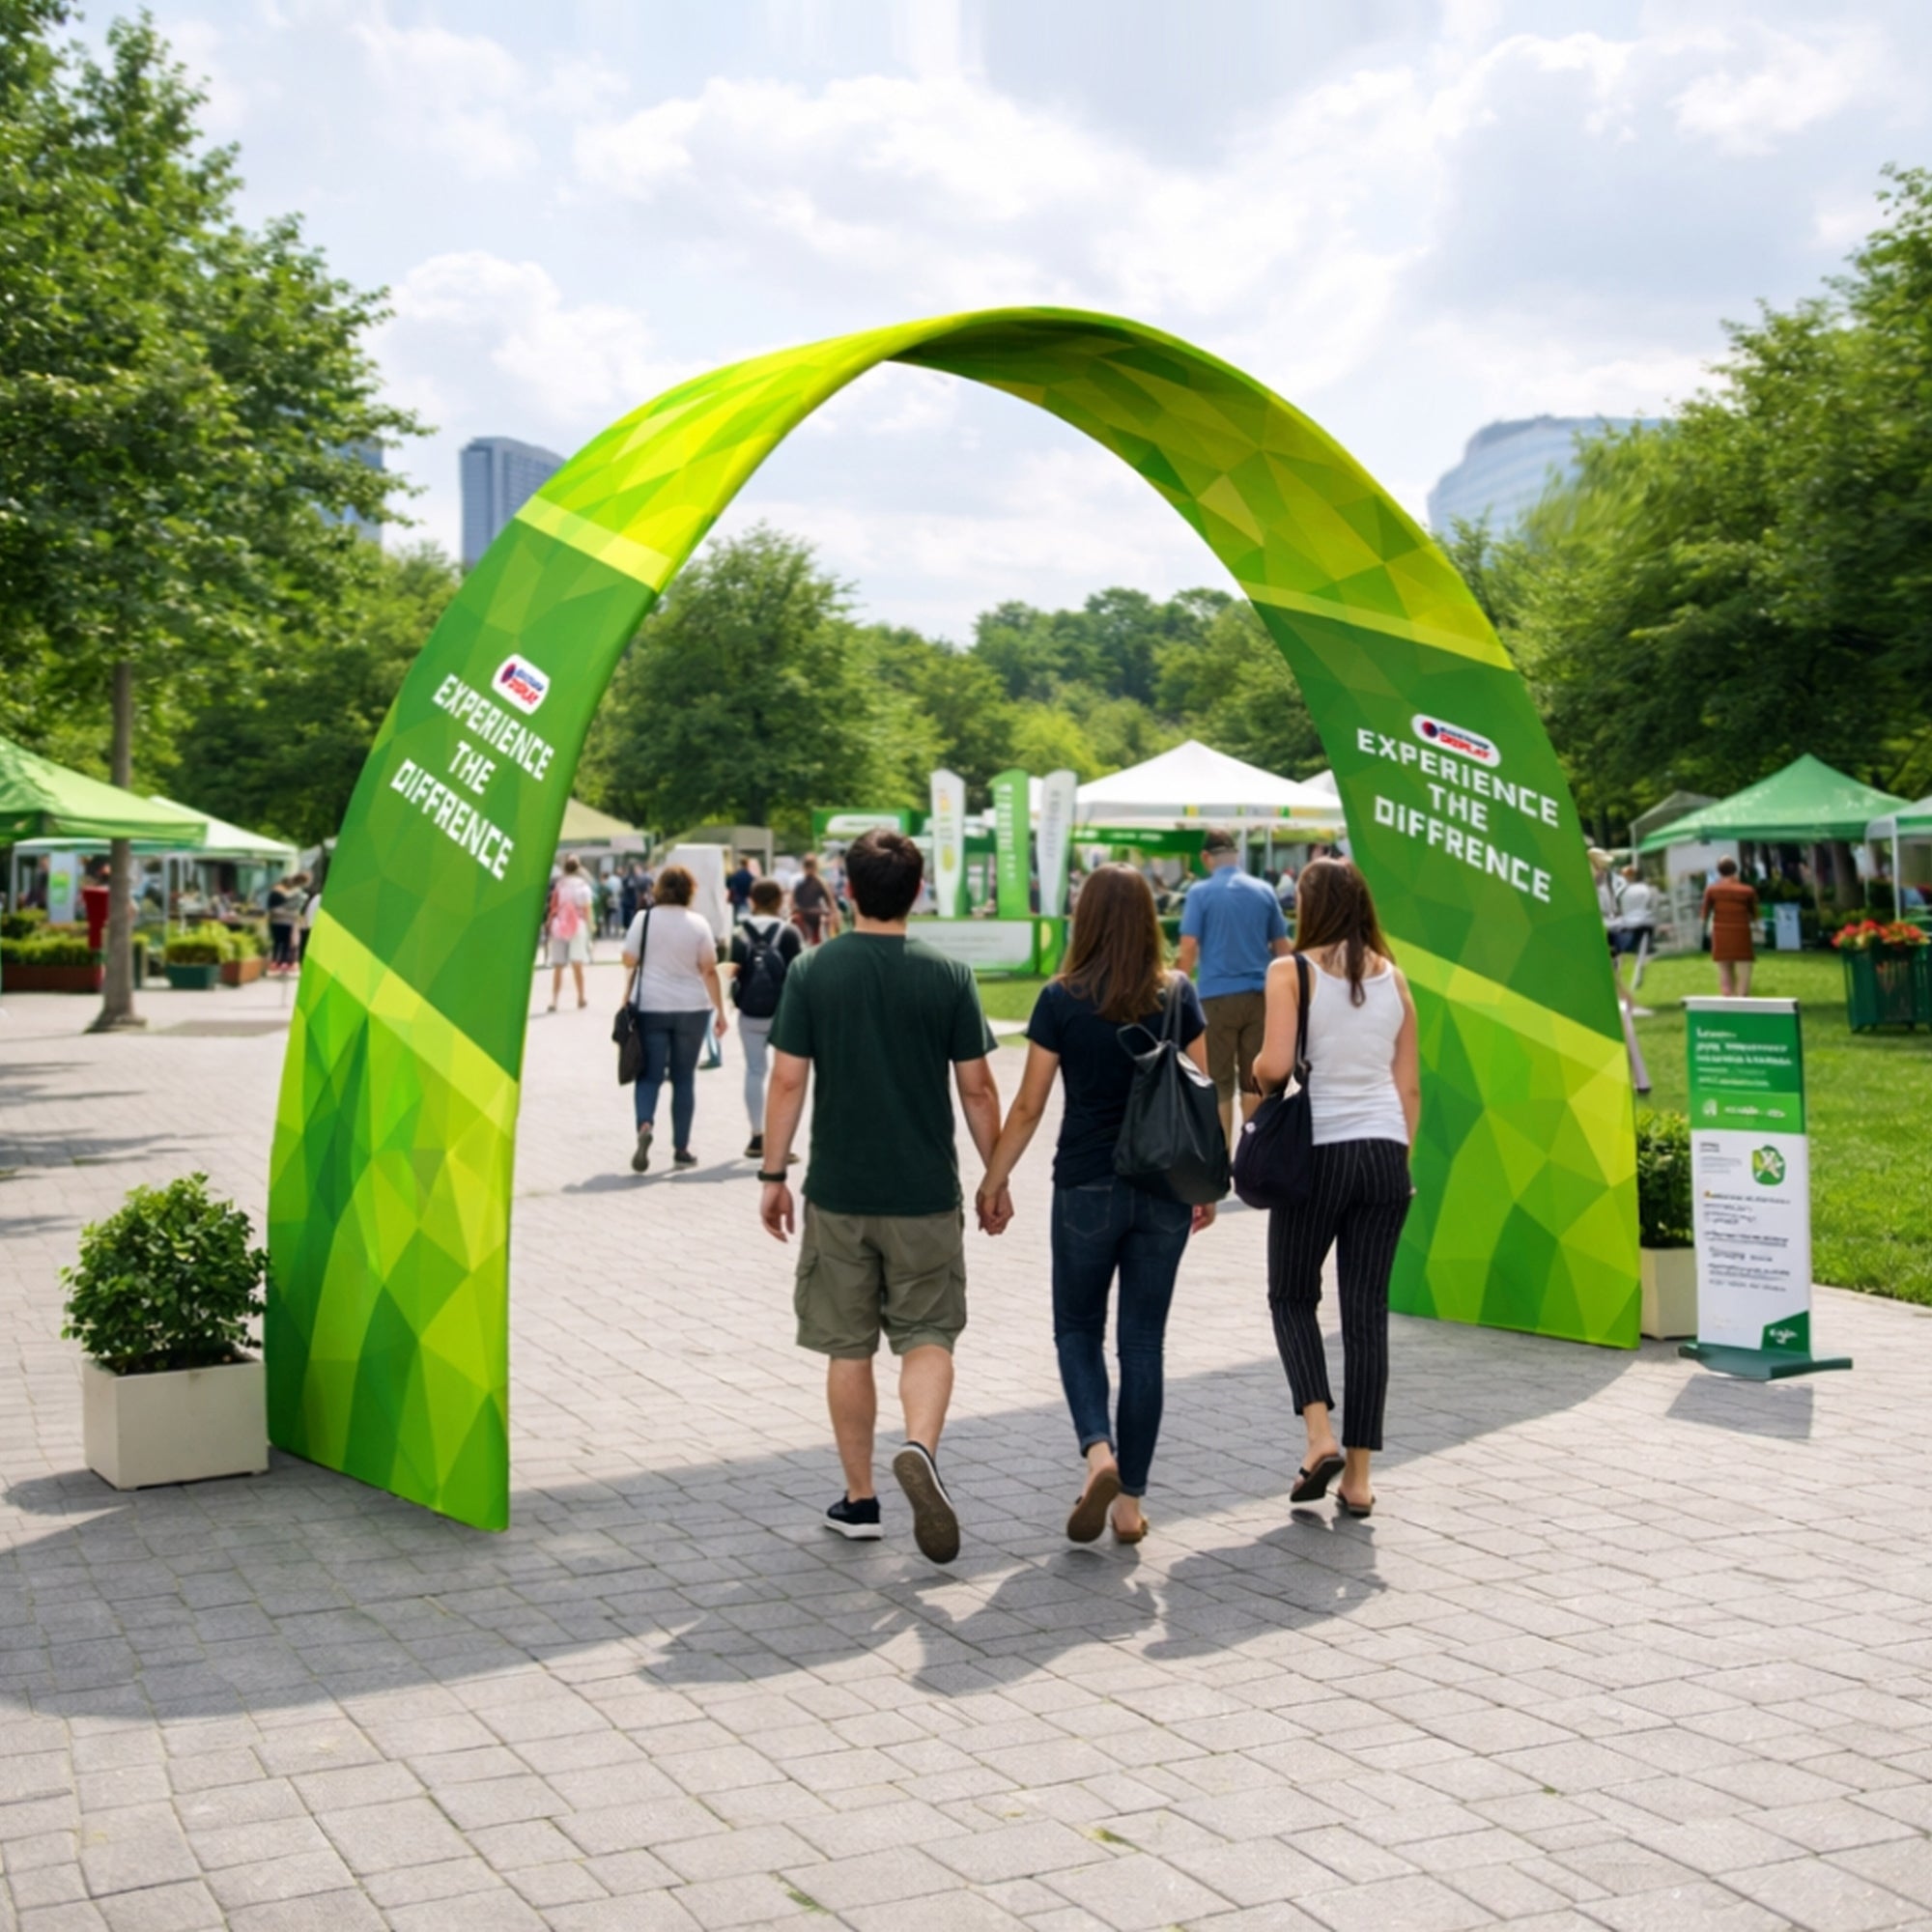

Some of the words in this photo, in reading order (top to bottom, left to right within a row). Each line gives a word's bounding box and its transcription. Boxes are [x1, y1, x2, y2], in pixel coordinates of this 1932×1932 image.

[432, 673, 554, 781] EXPERIENCE
[448, 740, 497, 795] THE
[1356, 727, 1558, 828] EXPERIENCE
[389, 757, 514, 881] DIFFRENCE
[1376, 795, 1551, 903] DIFFRENCE
[1427, 782, 1489, 832] THE
